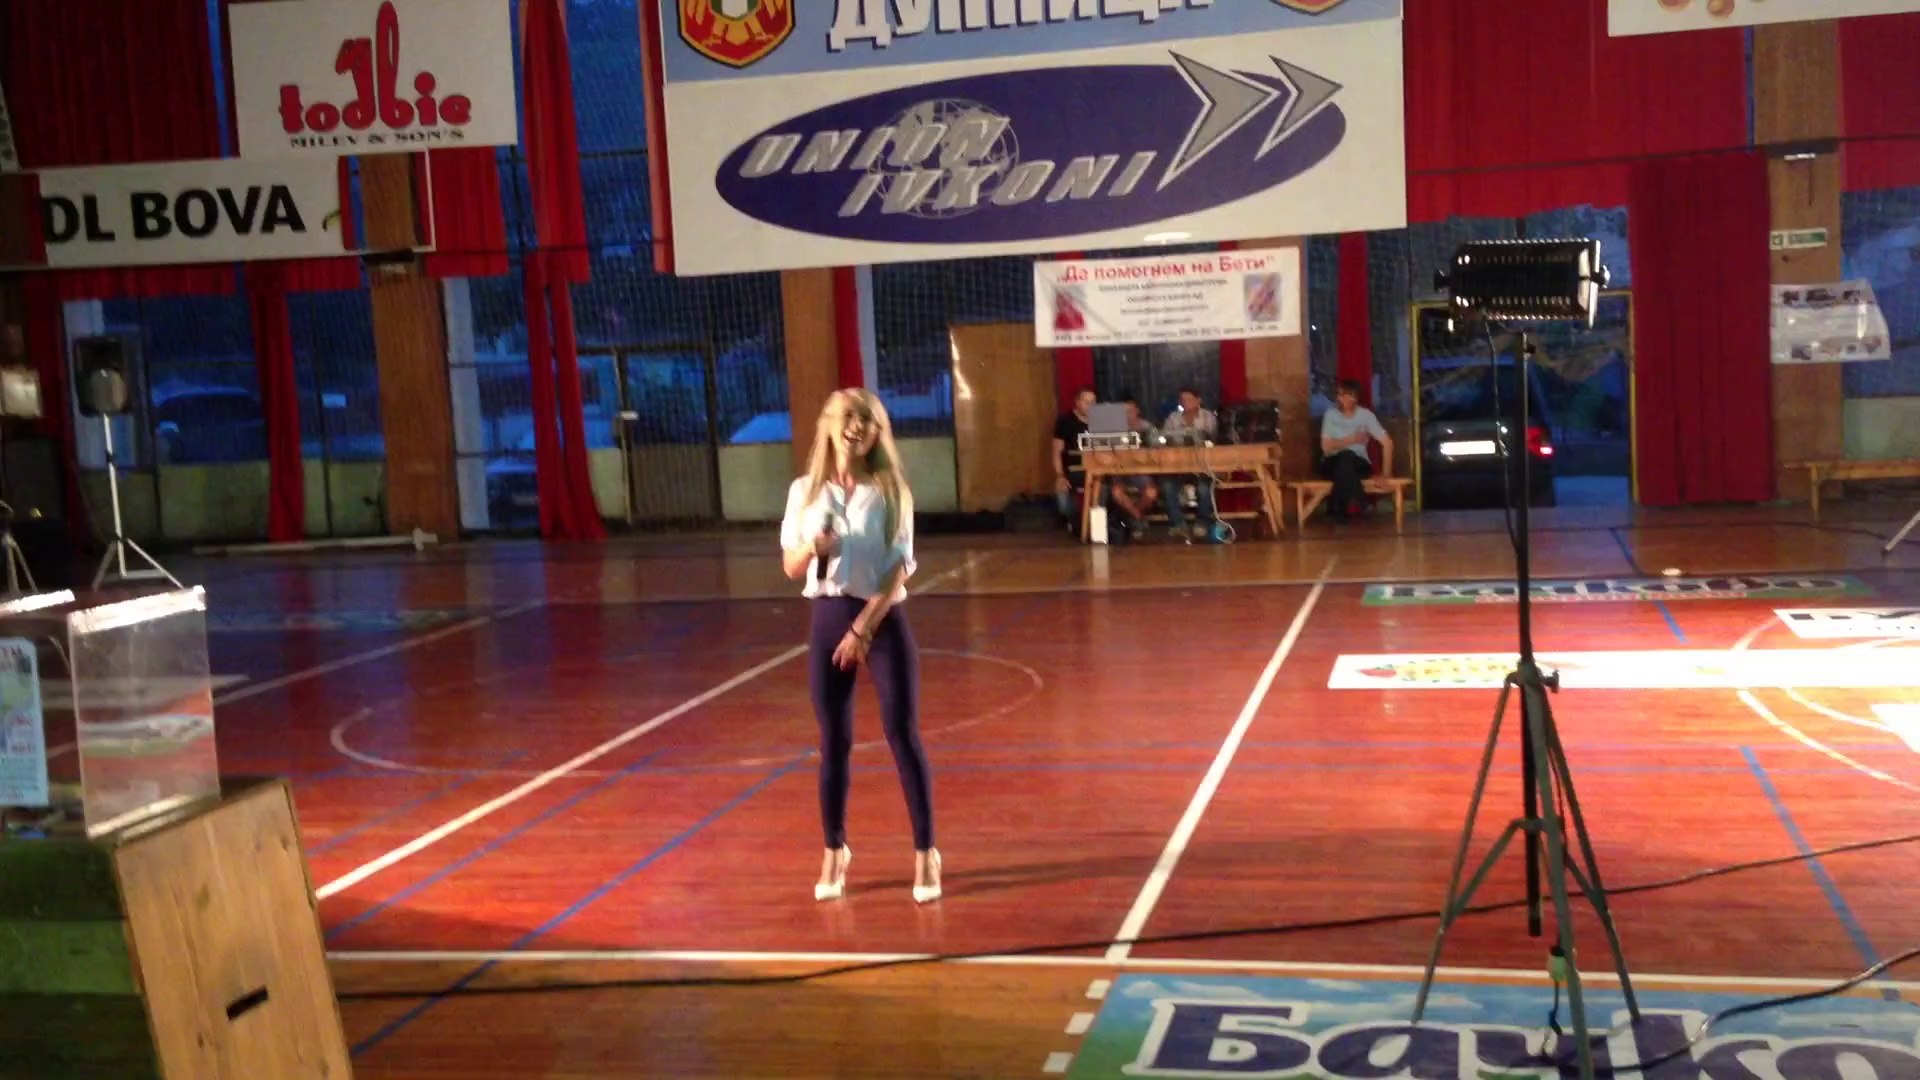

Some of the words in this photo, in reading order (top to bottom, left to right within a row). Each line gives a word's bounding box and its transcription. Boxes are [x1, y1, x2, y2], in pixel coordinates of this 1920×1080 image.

[278, 0, 472, 134] todbie
[290, 134, 358, 148] MILEV
[740, 115, 1011, 178] UNION
[130, 184, 307, 241] BOVA
[838, 151, 1157, 218] IVKONI
